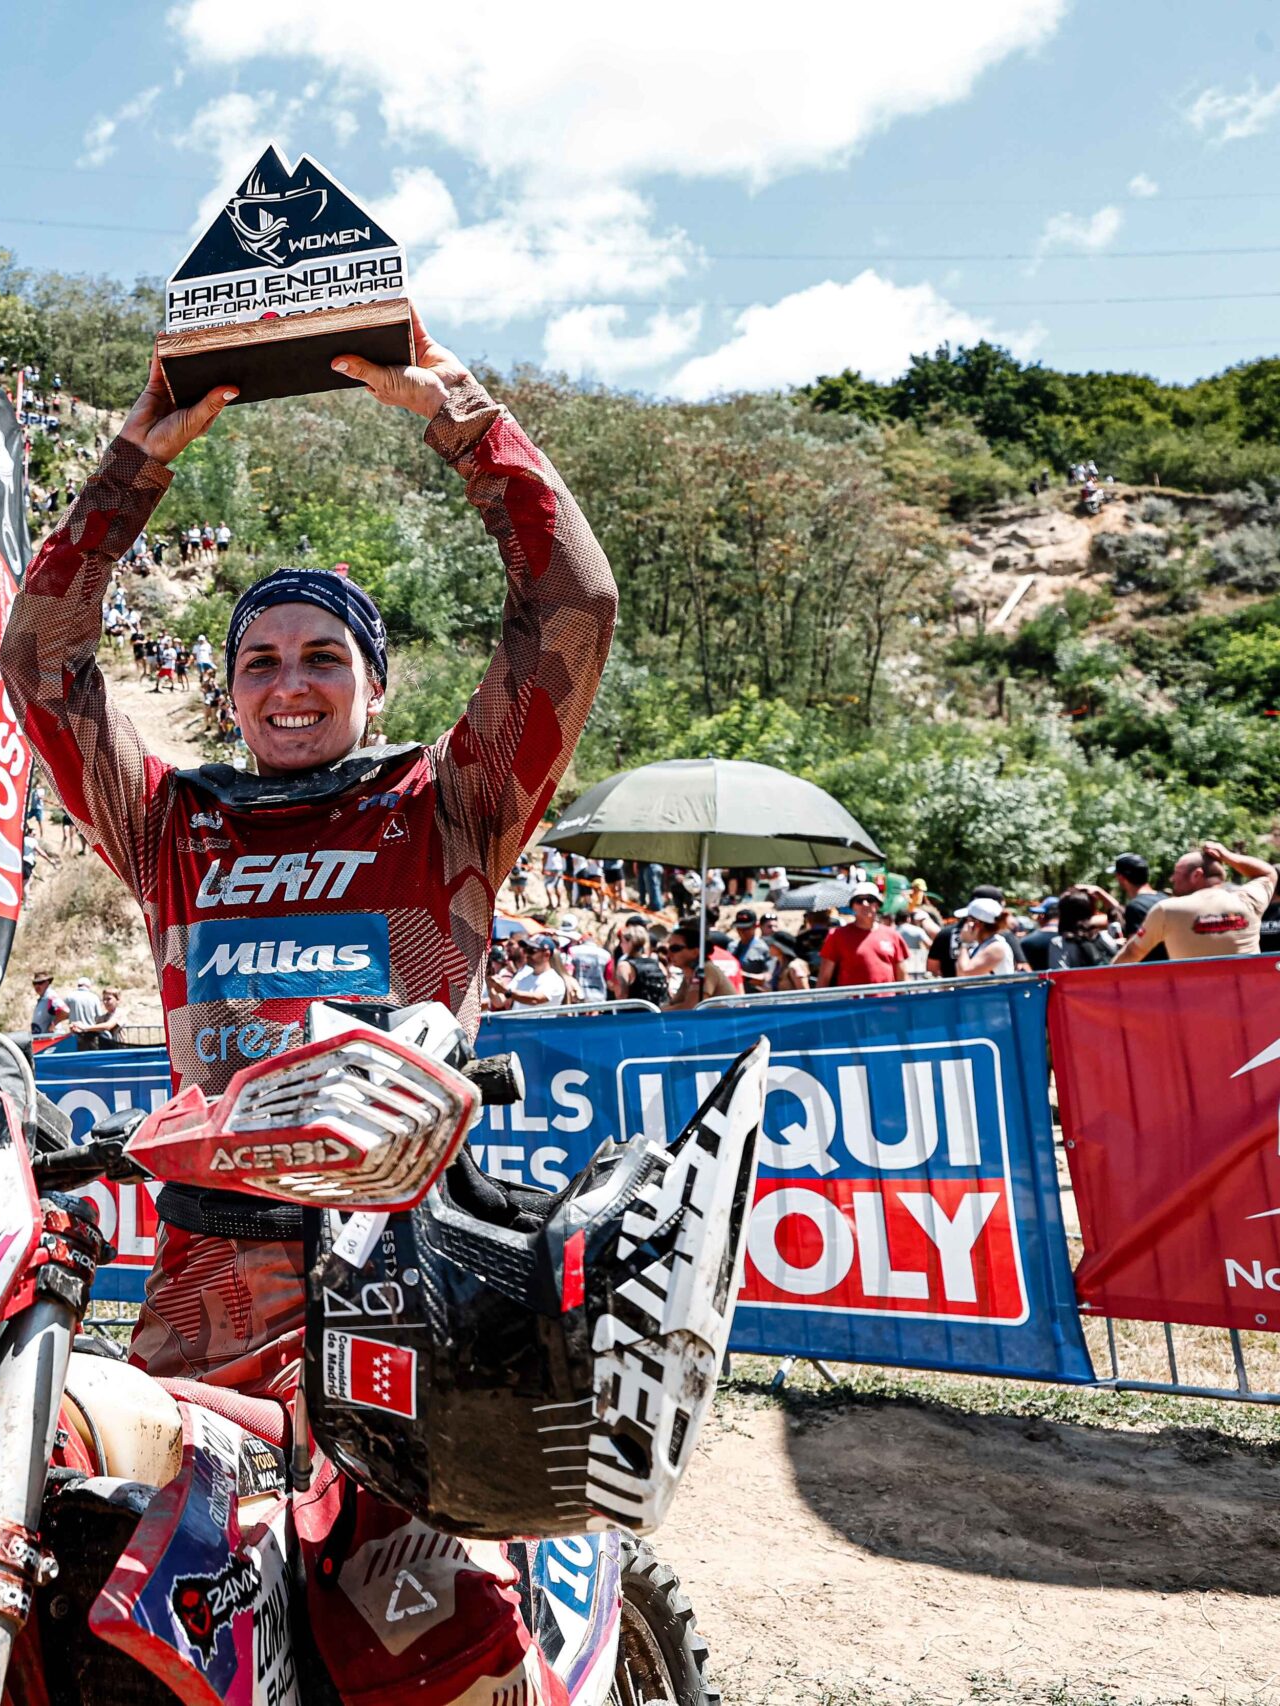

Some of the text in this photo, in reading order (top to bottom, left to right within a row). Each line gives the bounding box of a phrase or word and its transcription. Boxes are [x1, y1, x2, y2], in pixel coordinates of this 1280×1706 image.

[288, 226, 370, 252] WOMEN
[169, 278, 257, 309] HARD
[264, 256, 402, 294] ENDURO
[169, 288, 323, 322] PERFORMANCE
[328, 275, 403, 298] AWARD
[196, 850, 377, 909] LEATT
[197, 940, 371, 978] Mitas
[210, 1138, 351, 1171] ACERBIS
[738, 1187, 1002, 1304] OLY
[325, 1332, 337, 1398] de Madrid
[338, 1335, 348, 1399] Comunidad
[207, 1563, 260, 1616] 24MX
